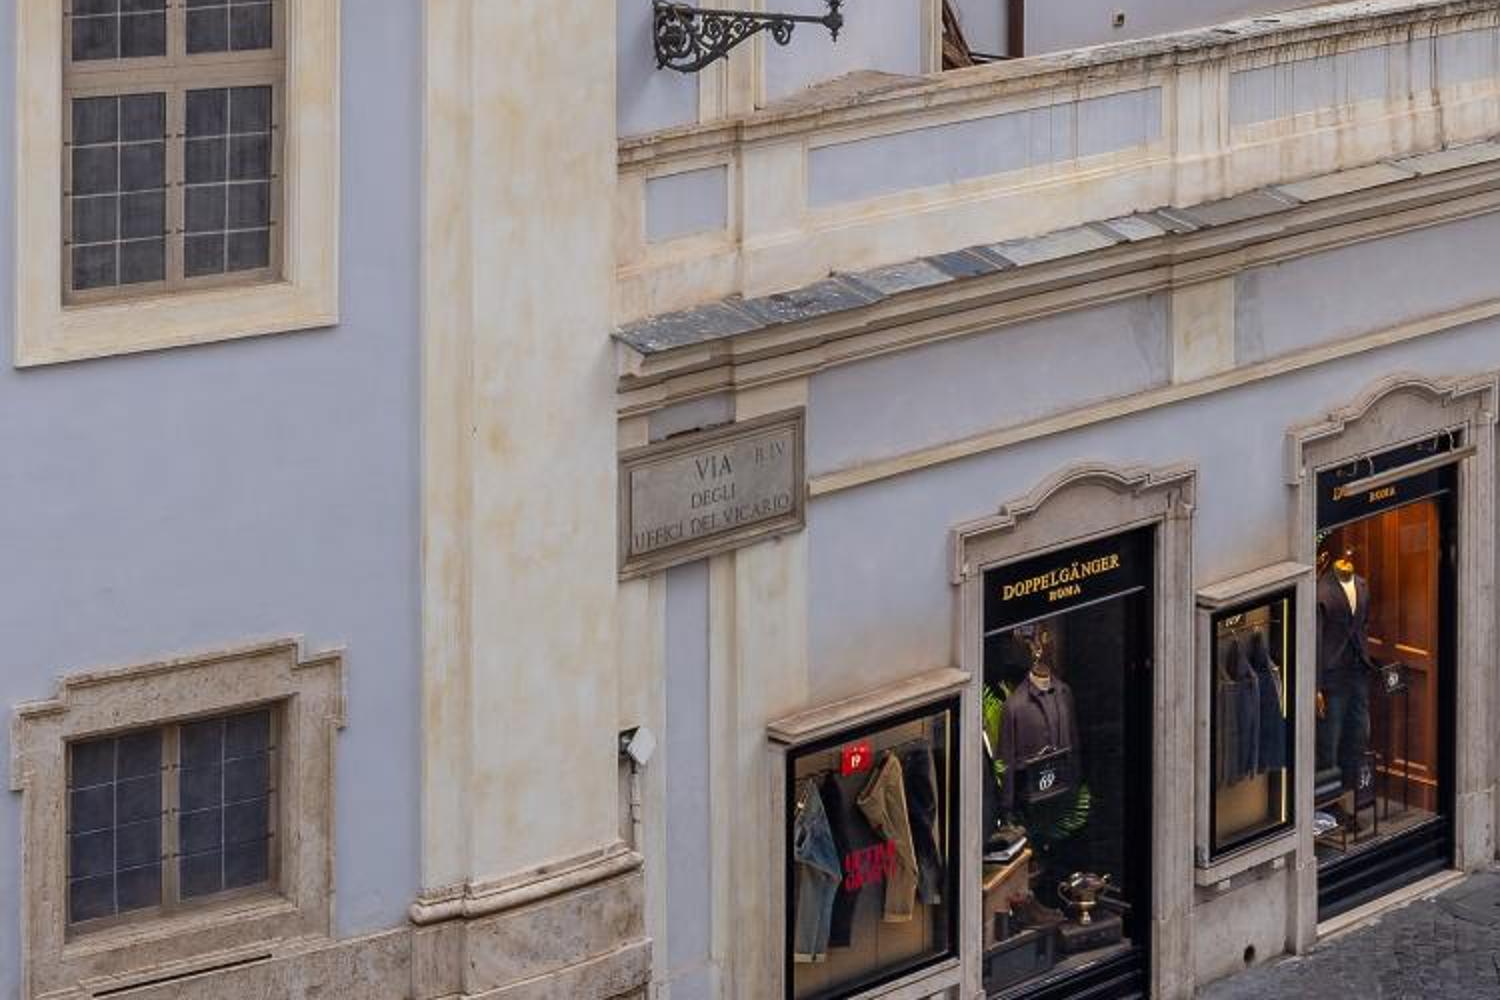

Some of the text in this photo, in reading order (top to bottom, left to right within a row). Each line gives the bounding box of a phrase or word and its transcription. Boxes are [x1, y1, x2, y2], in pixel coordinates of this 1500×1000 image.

[695, 455, 732, 480] VIA
[691, 482, 735, 509] DEGLI
[634, 520, 683, 549] UFFICI
[723, 493, 790, 523] VICARIO
[1003, 553, 1120, 600] DOPPELGÄNGER
[1049, 584, 1081, 601] ROMA
